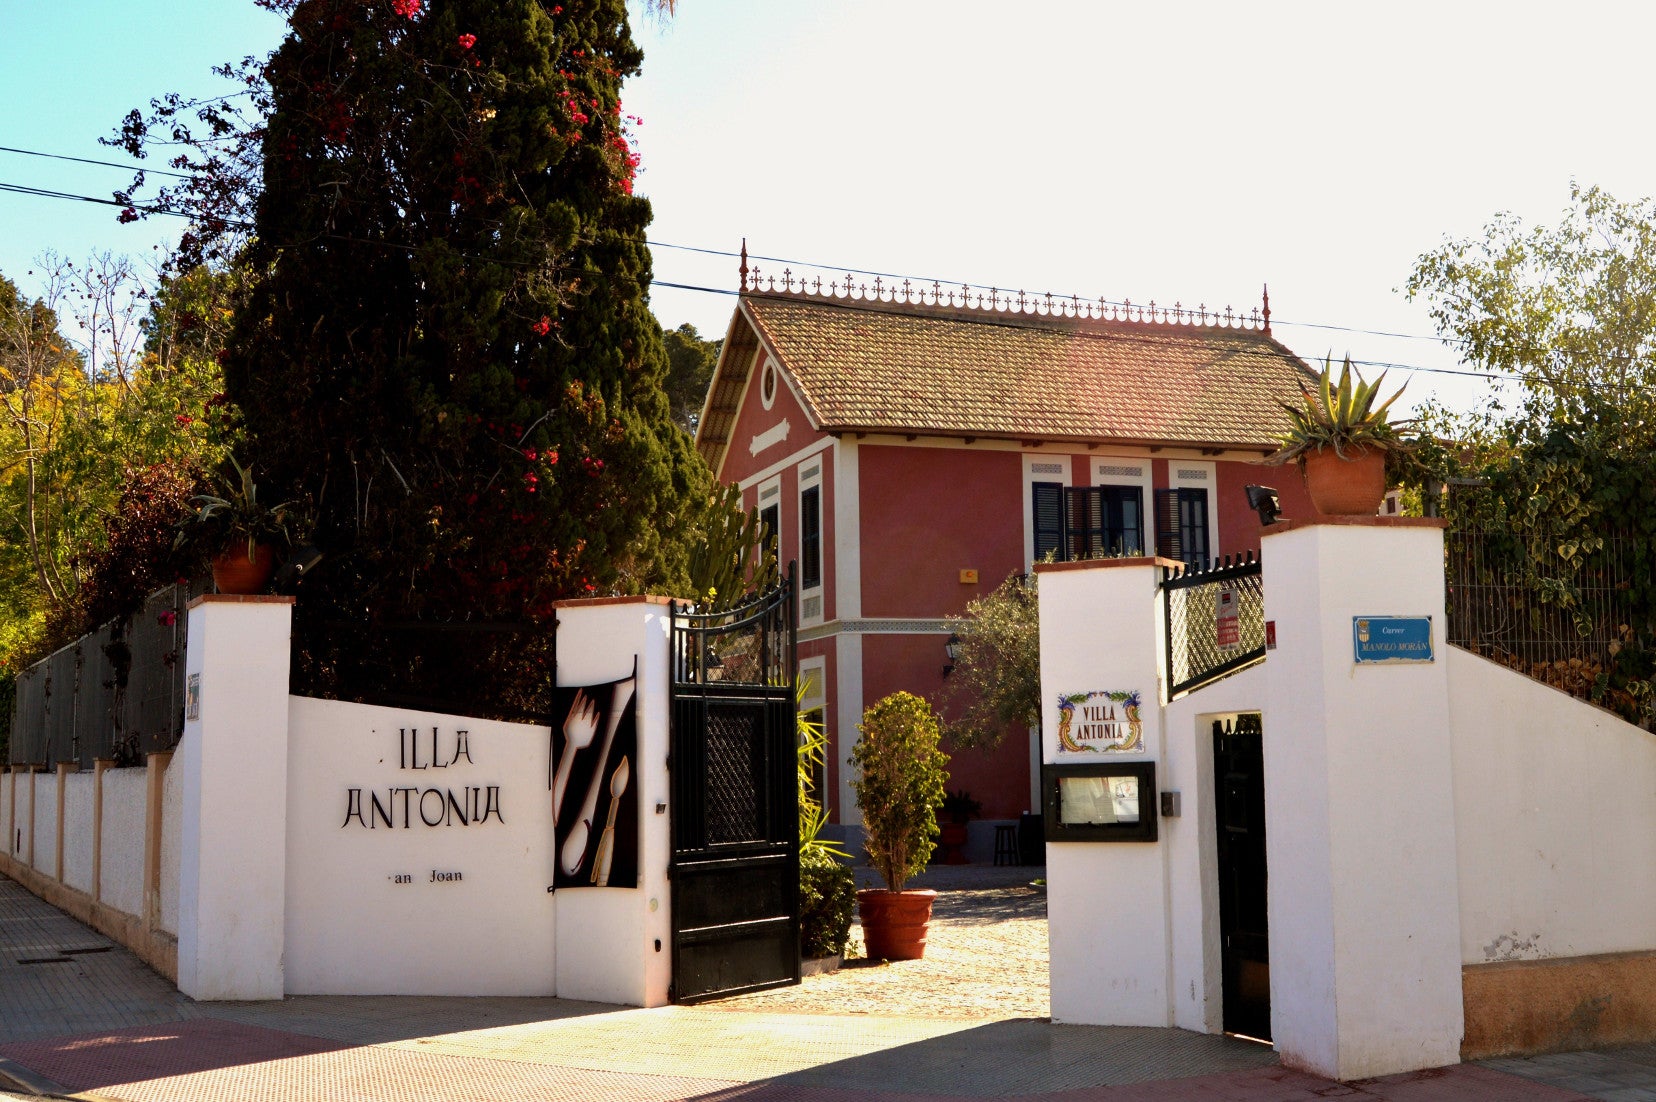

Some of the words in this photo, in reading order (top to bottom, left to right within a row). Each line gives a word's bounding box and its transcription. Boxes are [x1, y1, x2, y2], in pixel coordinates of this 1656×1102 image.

[1361, 642, 1397, 652] MANOLO
[1083, 705, 1117, 722] VILLA
[1076, 723, 1124, 741] ANTONIA
[341, 786, 505, 829] ANTONIA
[429, 869, 463, 883] Joan
